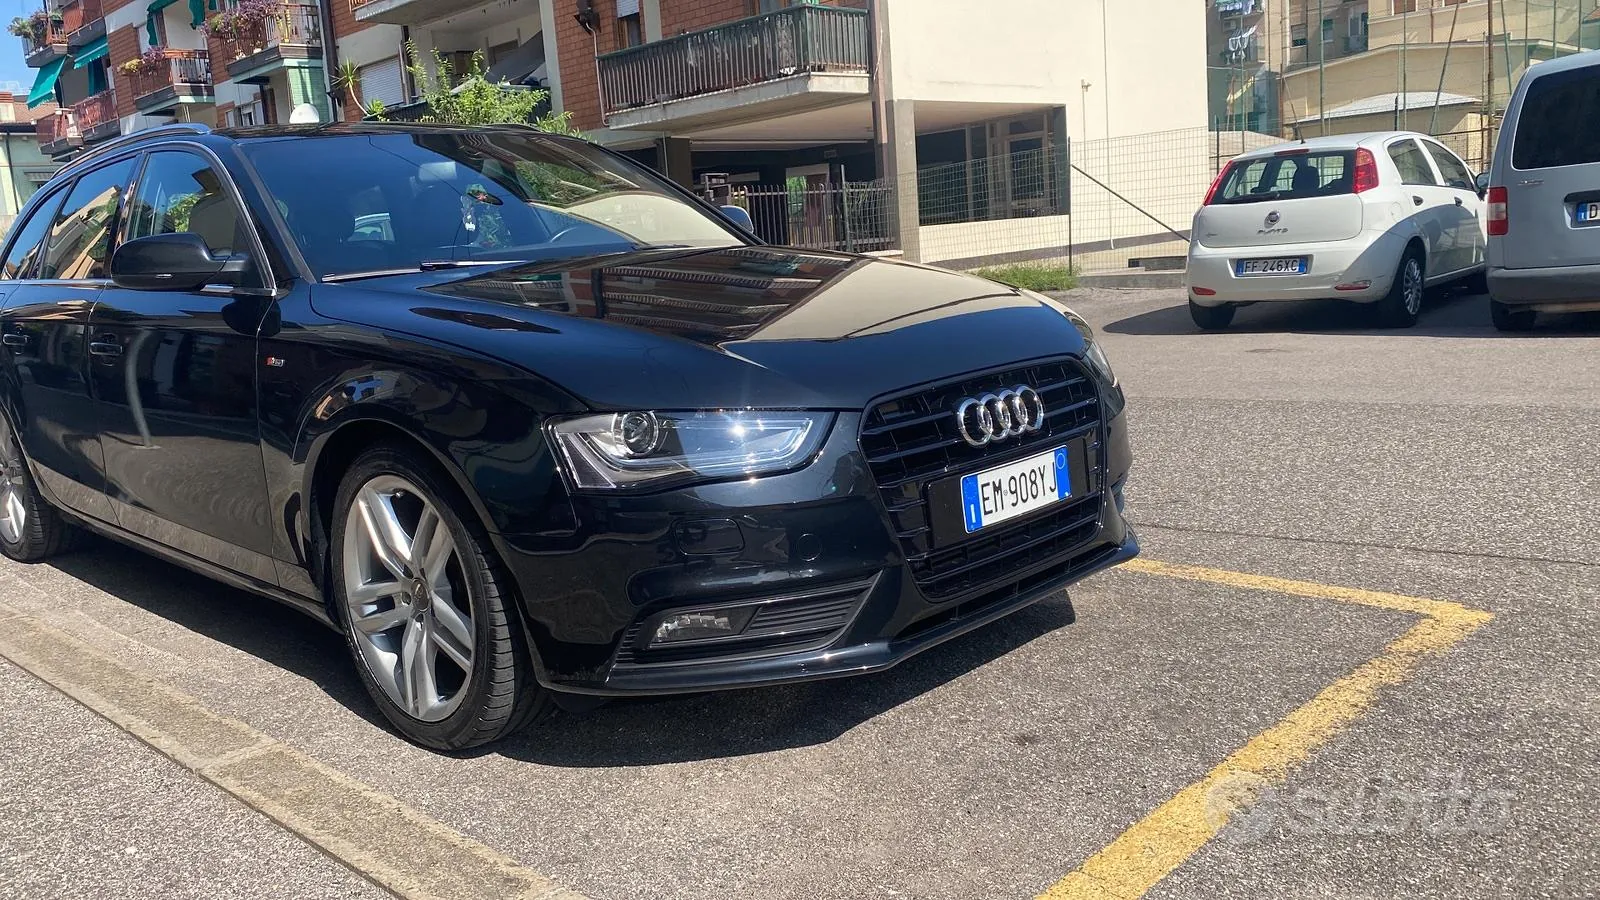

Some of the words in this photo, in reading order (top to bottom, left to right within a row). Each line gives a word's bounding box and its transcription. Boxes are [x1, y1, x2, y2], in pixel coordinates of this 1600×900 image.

[1244, 261, 1259, 273] FF
[1262, 259, 1298, 273] 246XC
[980, 478, 1005, 516] EM
[1008, 461, 1057, 507] 908YJ
